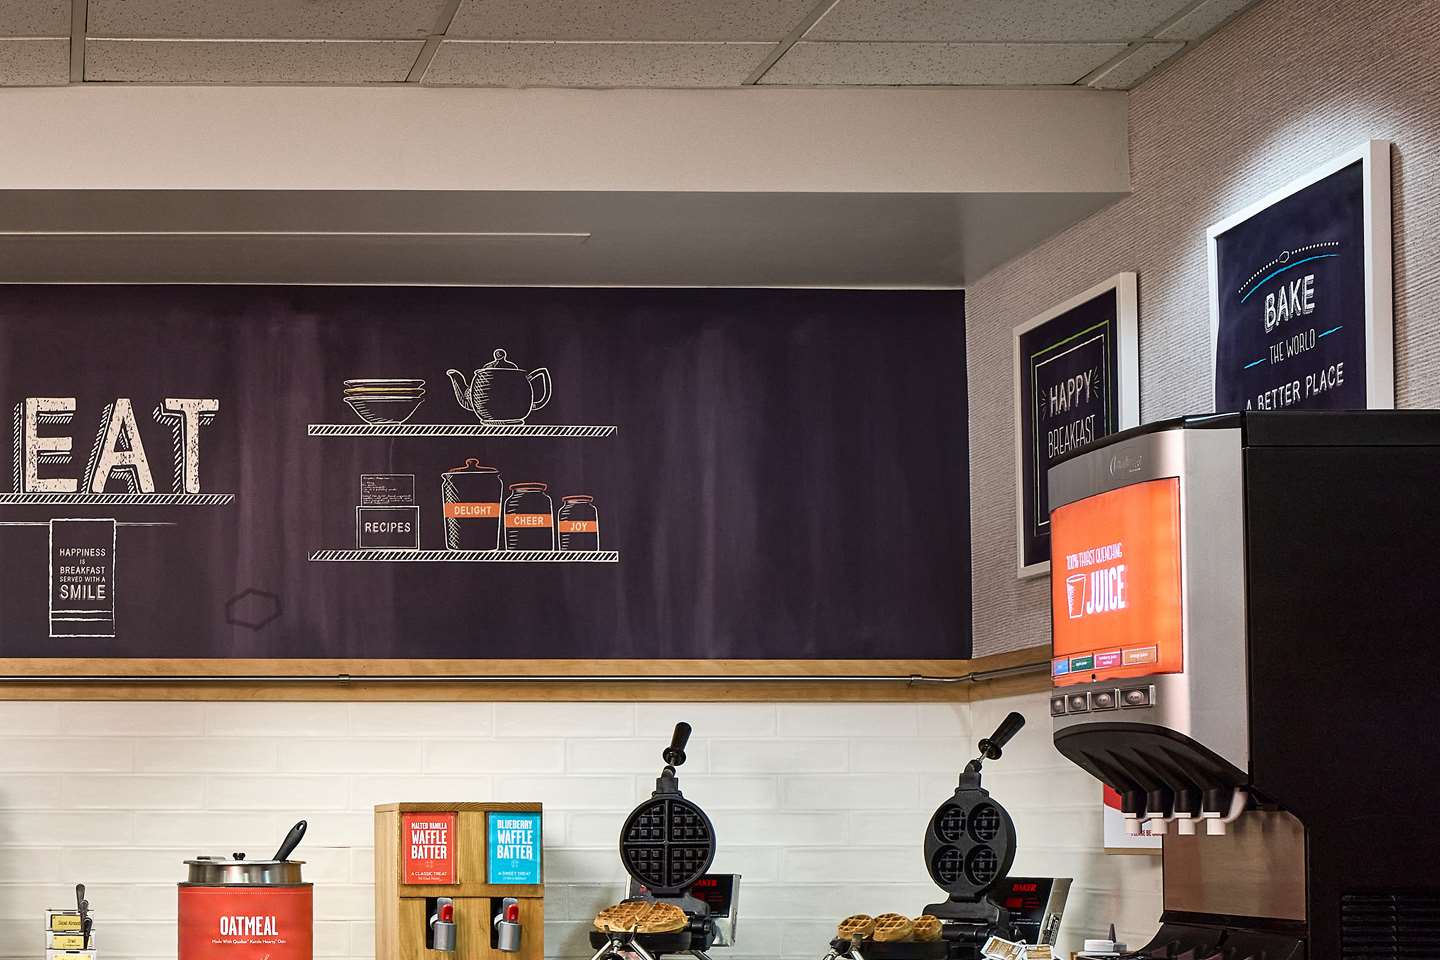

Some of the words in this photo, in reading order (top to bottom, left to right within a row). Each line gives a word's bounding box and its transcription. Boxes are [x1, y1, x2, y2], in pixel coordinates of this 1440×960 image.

[1264, 274, 1316, 334] BAKE
[1269, 341, 1284, 364] THE
[1285, 328, 1316, 358] WORLD
[1049, 369, 1093, 418] HAPPY
[1257, 380, 1301, 411] BETTER
[1305, 362, 1344, 396] PLACE
[1048, 414, 1096, 459] BREAKFAST
[14, 397, 220, 494] EAT
[454, 505, 492, 516] DELIGHT
[364, 521, 411, 533] RECIPES
[513, 516, 545, 526] CHEER
[570, 522, 588, 532] JOY
[59, 548, 106, 557] HAPPINESS
[59, 566, 106, 575] BREAKFAST
[59, 575, 83, 583] SERVED
[60, 584, 106, 600] SMILE
[1086, 564, 1126, 615] JUICE
[497, 819, 532, 829] BLUEBERRY
[411, 829, 447, 845] WAFFLE
[497, 829, 533, 845] WAFFLE
[411, 845, 447, 859] BATTER
[496, 845, 533, 860] BATTER
[220, 915, 279, 936] OATMEAL
